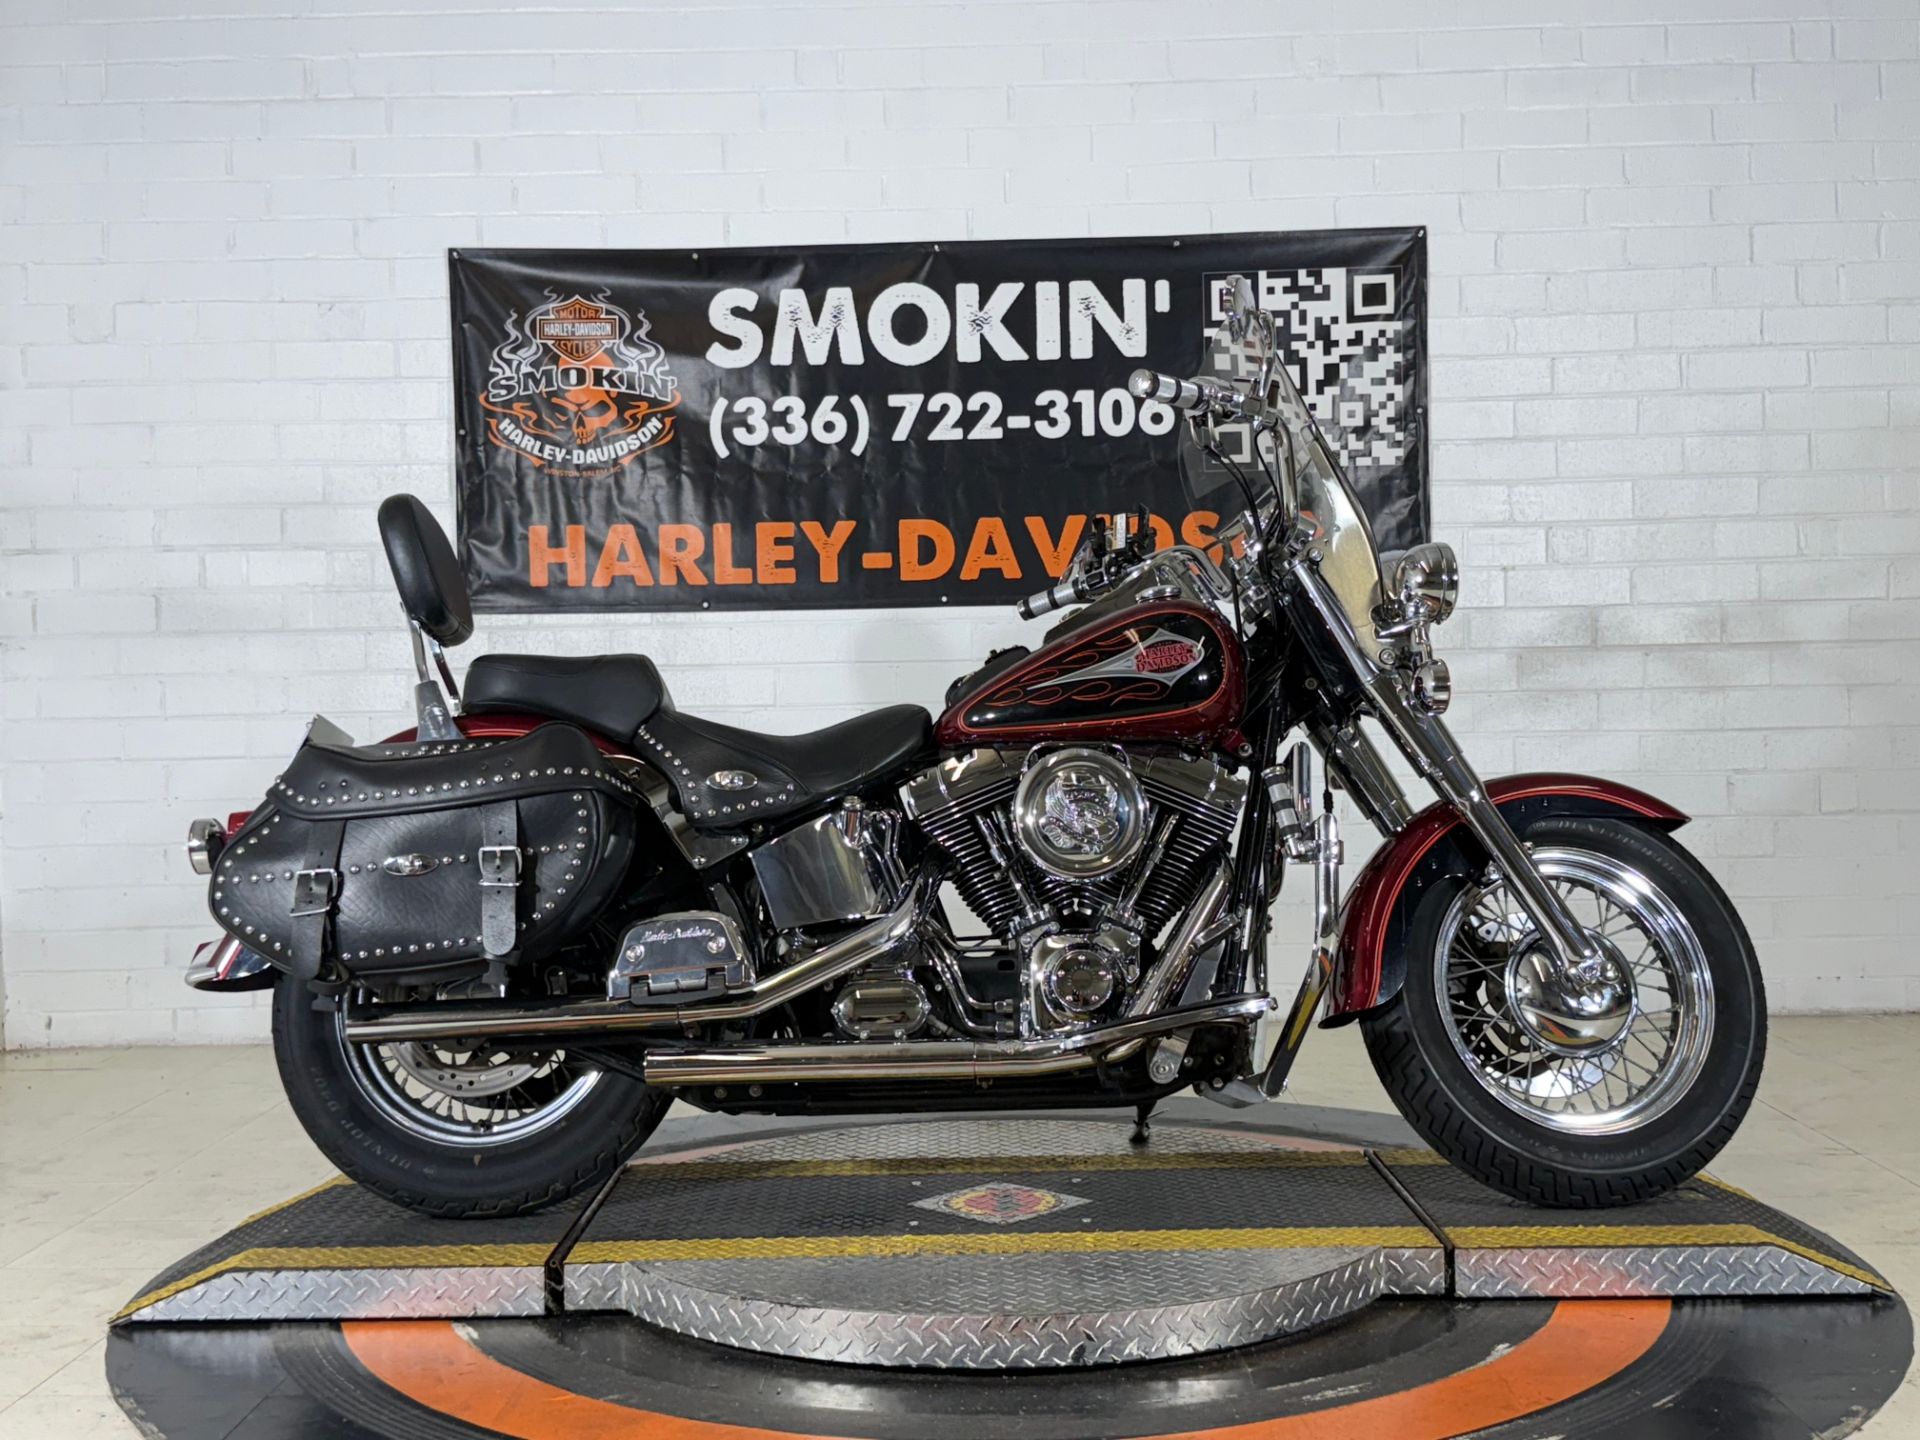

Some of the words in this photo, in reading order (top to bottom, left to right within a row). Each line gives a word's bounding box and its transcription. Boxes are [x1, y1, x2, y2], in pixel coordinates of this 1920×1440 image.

[544, 323, 611, 336] HARLEY-DAVIDSON
[560, 304, 596, 319] MOTOR
[705, 278, 1171, 368] SMOKIN'
[560, 340, 596, 357] CYCLES
[489, 365, 677, 402] SMOKIN'
[498, 417, 664, 465] HARLEY-DAVIDSON
[709, 394, 869, 459] (336)
[888, 388, 1176, 442] 722-3106
